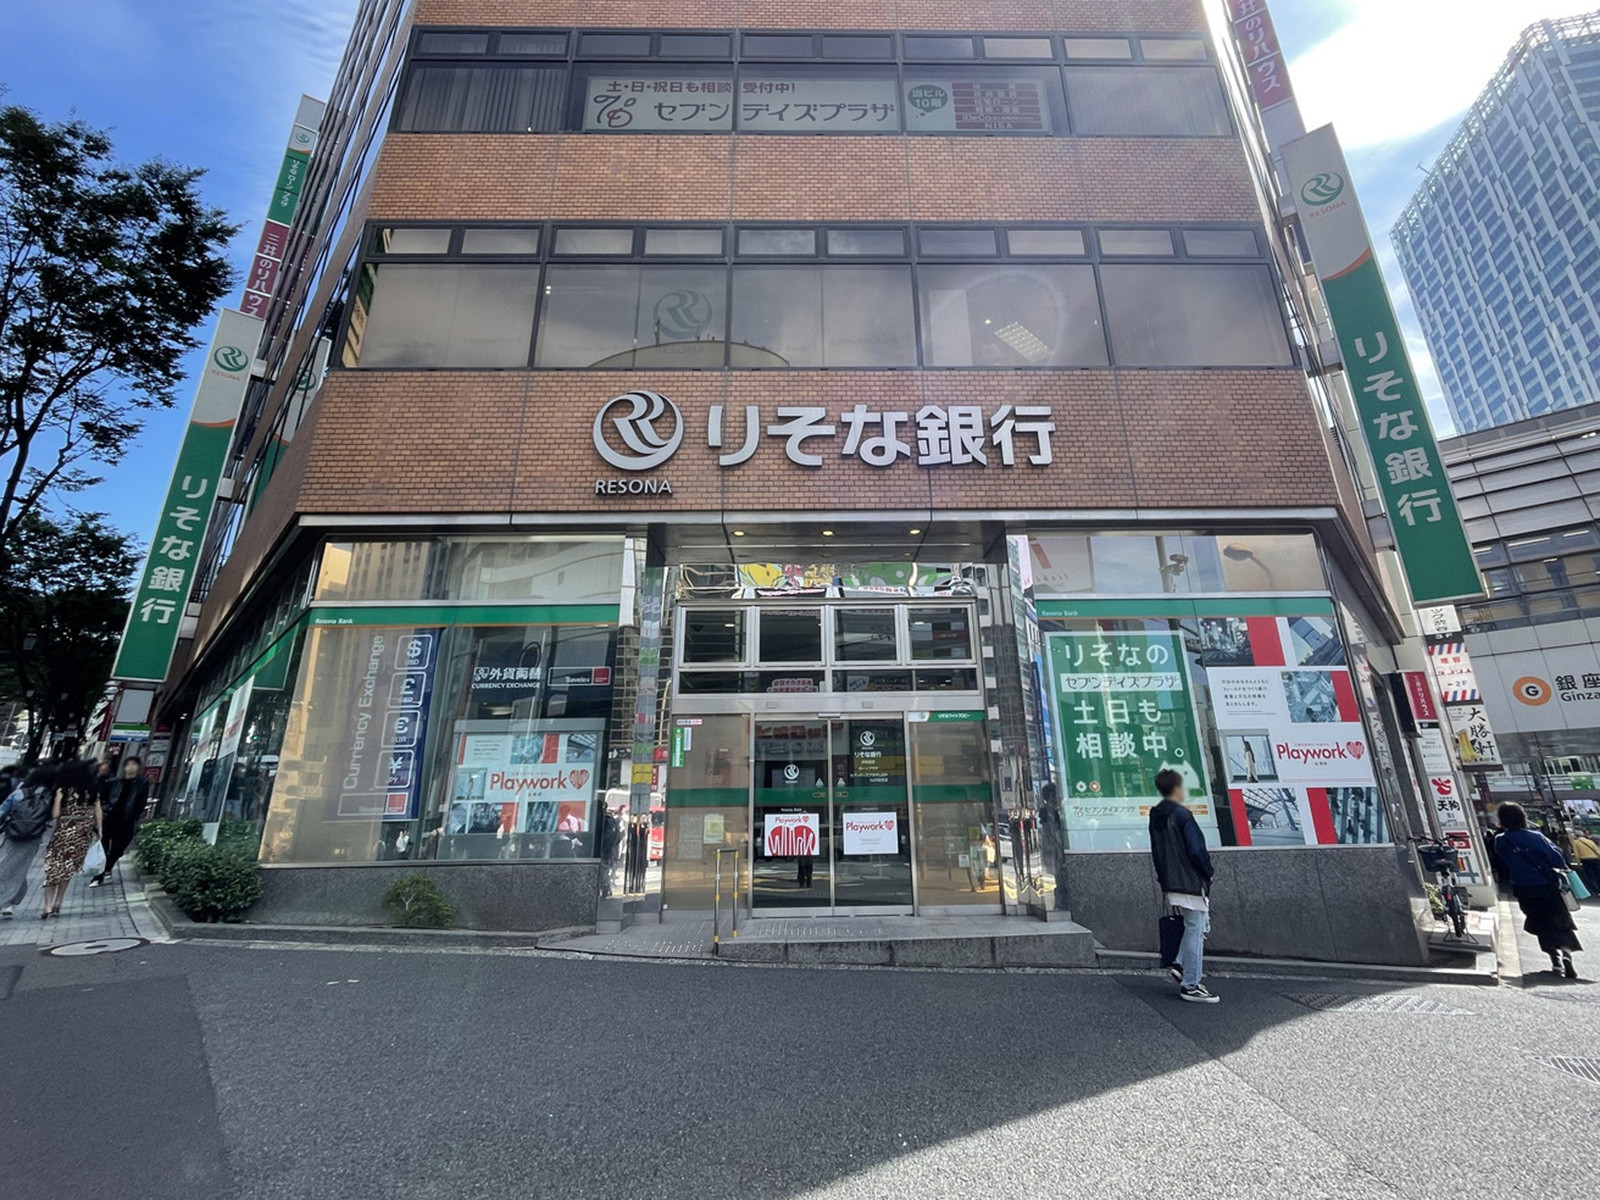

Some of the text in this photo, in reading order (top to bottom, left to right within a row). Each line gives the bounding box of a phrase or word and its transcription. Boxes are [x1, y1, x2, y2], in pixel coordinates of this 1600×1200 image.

[606, 81, 796, 94] 土・日・祝日も相談 受付中!
[653, 102, 895, 122] セブン デイズプラザ
[707, 404, 1056, 468] りそな銀行
[1354, 331, 1442, 527] りそな銀行
[595, 478, 672, 495] RESONA
[139, 474, 208, 625] りそな銀行
[1065, 643, 1169, 667] りそなの
[489, 667, 541, 681] 外貨両替
[1066, 675, 1179, 689] セブンデイズプラザ
[1555, 673, 1600, 691] 銀座
[1525, 685, 1540, 697] G
[1561, 691, 1600, 702] Ginza
[343, 635, 385, 789] Currency Exchange
[1073, 699, 1162, 725] 土日も
[1467, 706, 1496, 757] 大勝軒
[1076, 732, 1185, 759] 相談中。
[1276, 741, 1348, 765] Playwork
[489, 769, 568, 796] Playwork
[1437, 800, 1461, 812] 天狗
[774, 815, 802, 825] Playwork
[845, 821, 885, 834] Playwork
